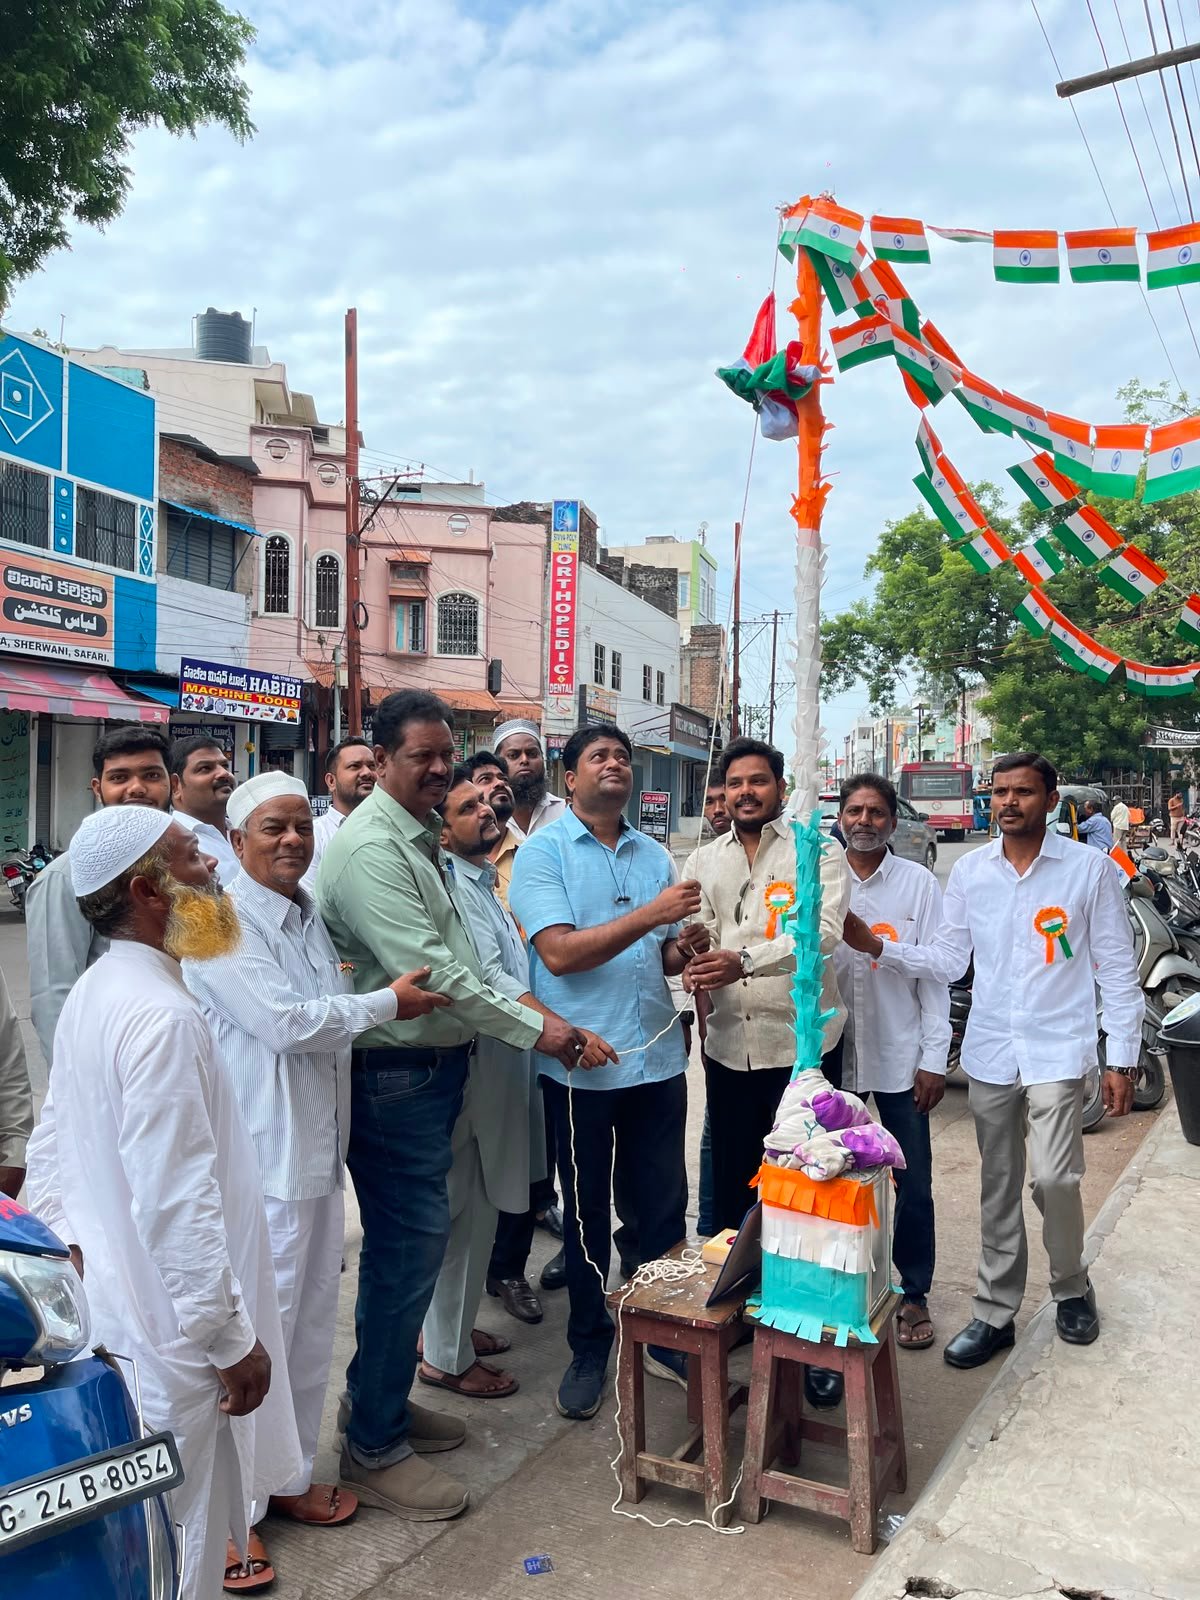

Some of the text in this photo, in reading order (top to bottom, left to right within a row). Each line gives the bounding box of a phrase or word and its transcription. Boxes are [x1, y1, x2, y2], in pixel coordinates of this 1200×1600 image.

[553, 554, 573, 675] ORTHOPEDIC
[14, 639, 71, 657] SHERWANI,
[74, 649, 110, 663] SAFARI.
[185, 684, 299, 708] MACHINE TOOLS
[249, 676, 302, 699] HABIBI
[549, 683, 573, 693] DENTAL
[0, 1403, 33, 1430] VS
[36, 1482, 72, 1519] 24
[79, 1474, 97, 1501] B
[106, 1449, 168, 1491] 8054
